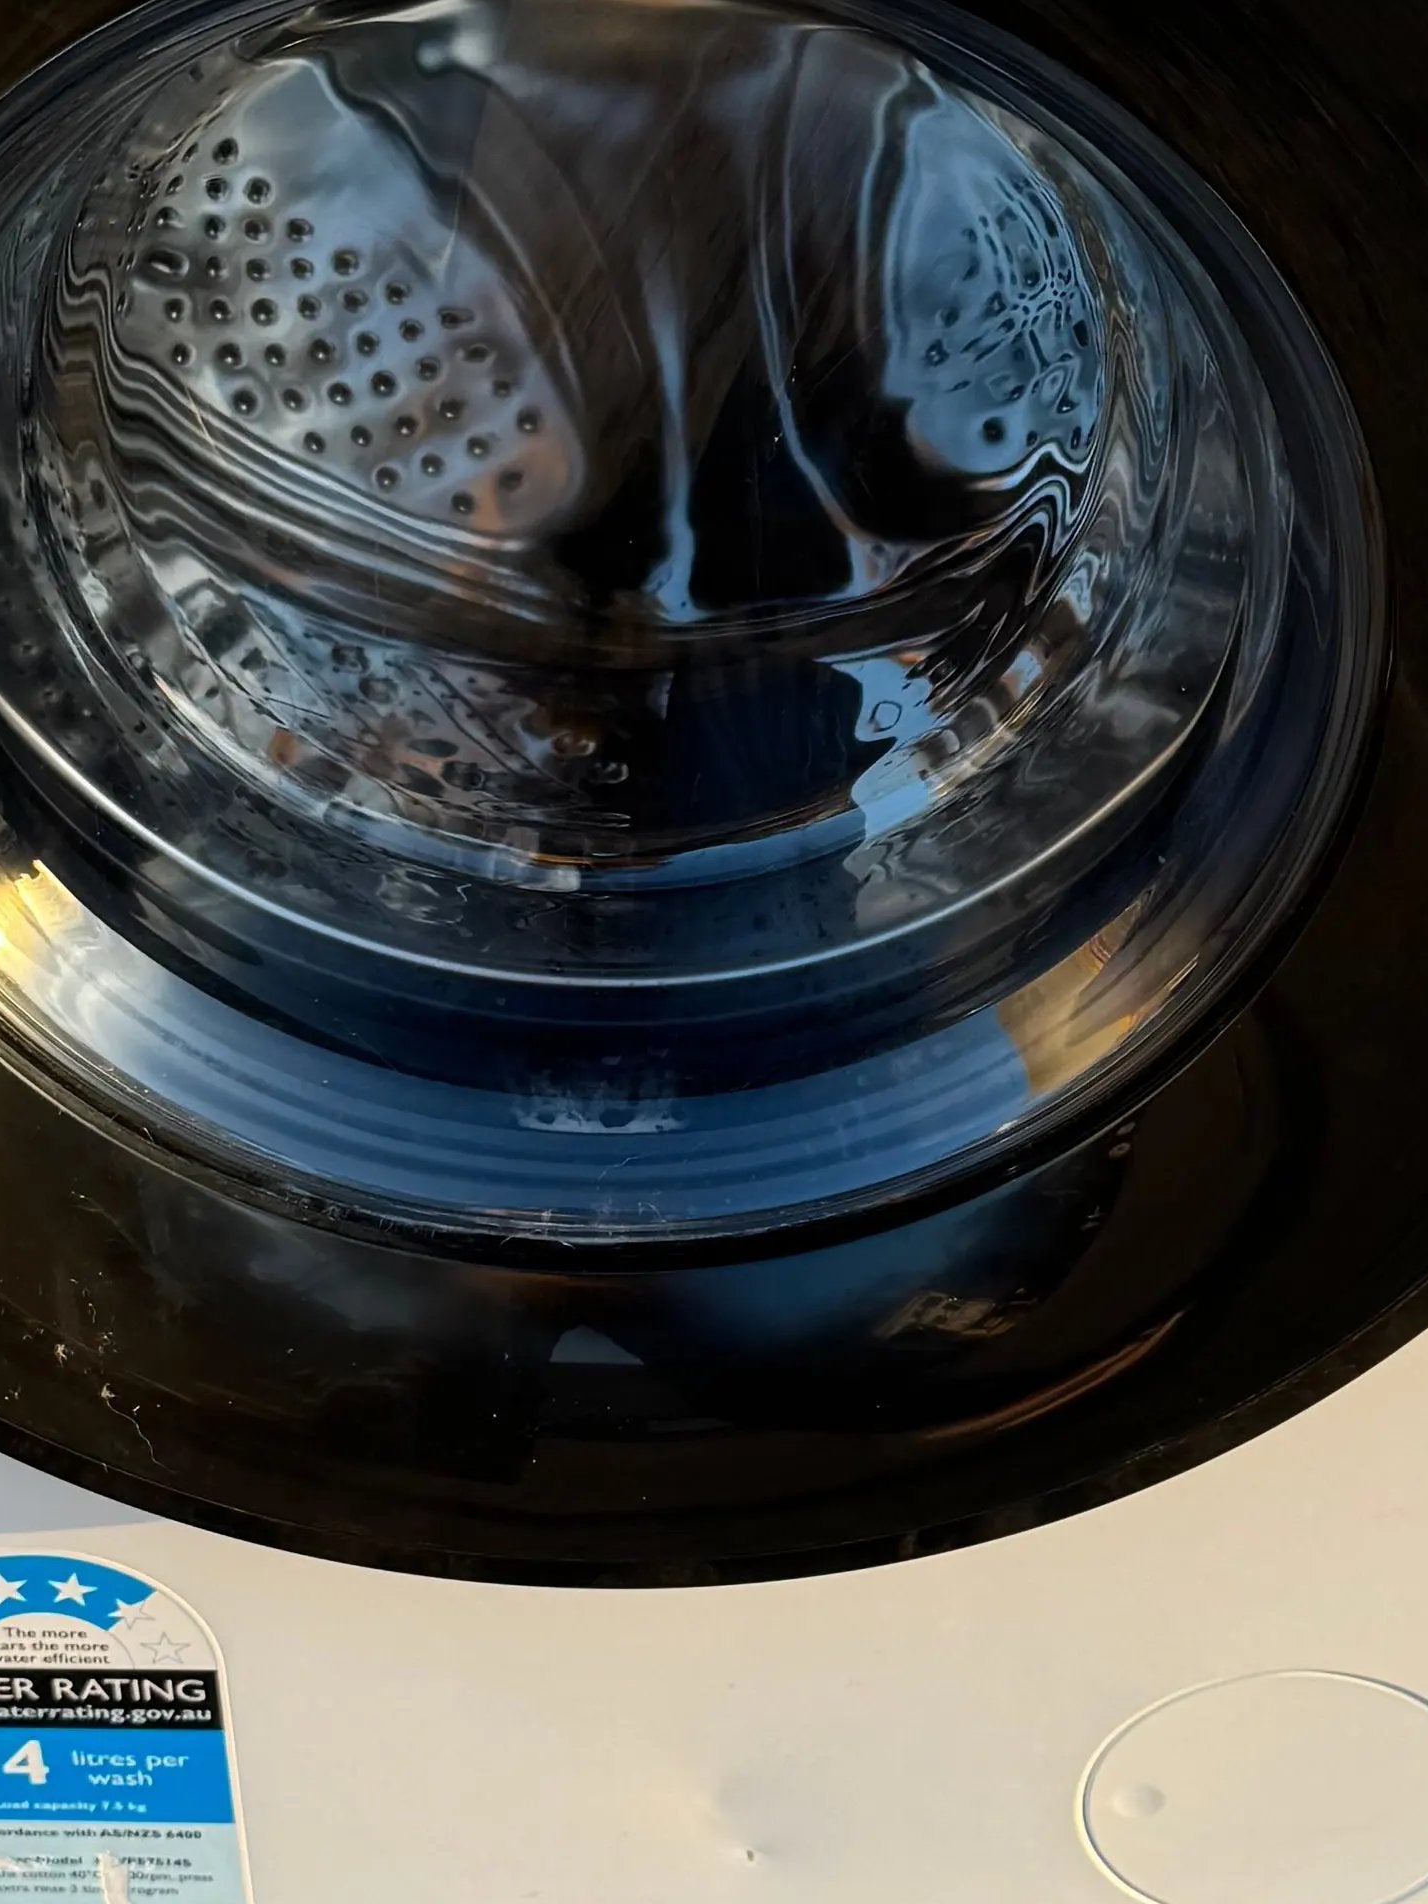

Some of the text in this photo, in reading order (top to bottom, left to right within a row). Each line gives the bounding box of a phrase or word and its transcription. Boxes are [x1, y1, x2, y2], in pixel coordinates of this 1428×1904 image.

[3, 1626, 87, 1638] The more
[31, 1641, 59, 1651] the
[64, 1642, 109, 1652] more
[42, 1653, 110, 1664] efficient
[49, 1678, 207, 1703] RATING
[72, 1750, 136, 1767] litres
[146, 1753, 190, 1772] per
[87, 1770, 153, 1786] wash
